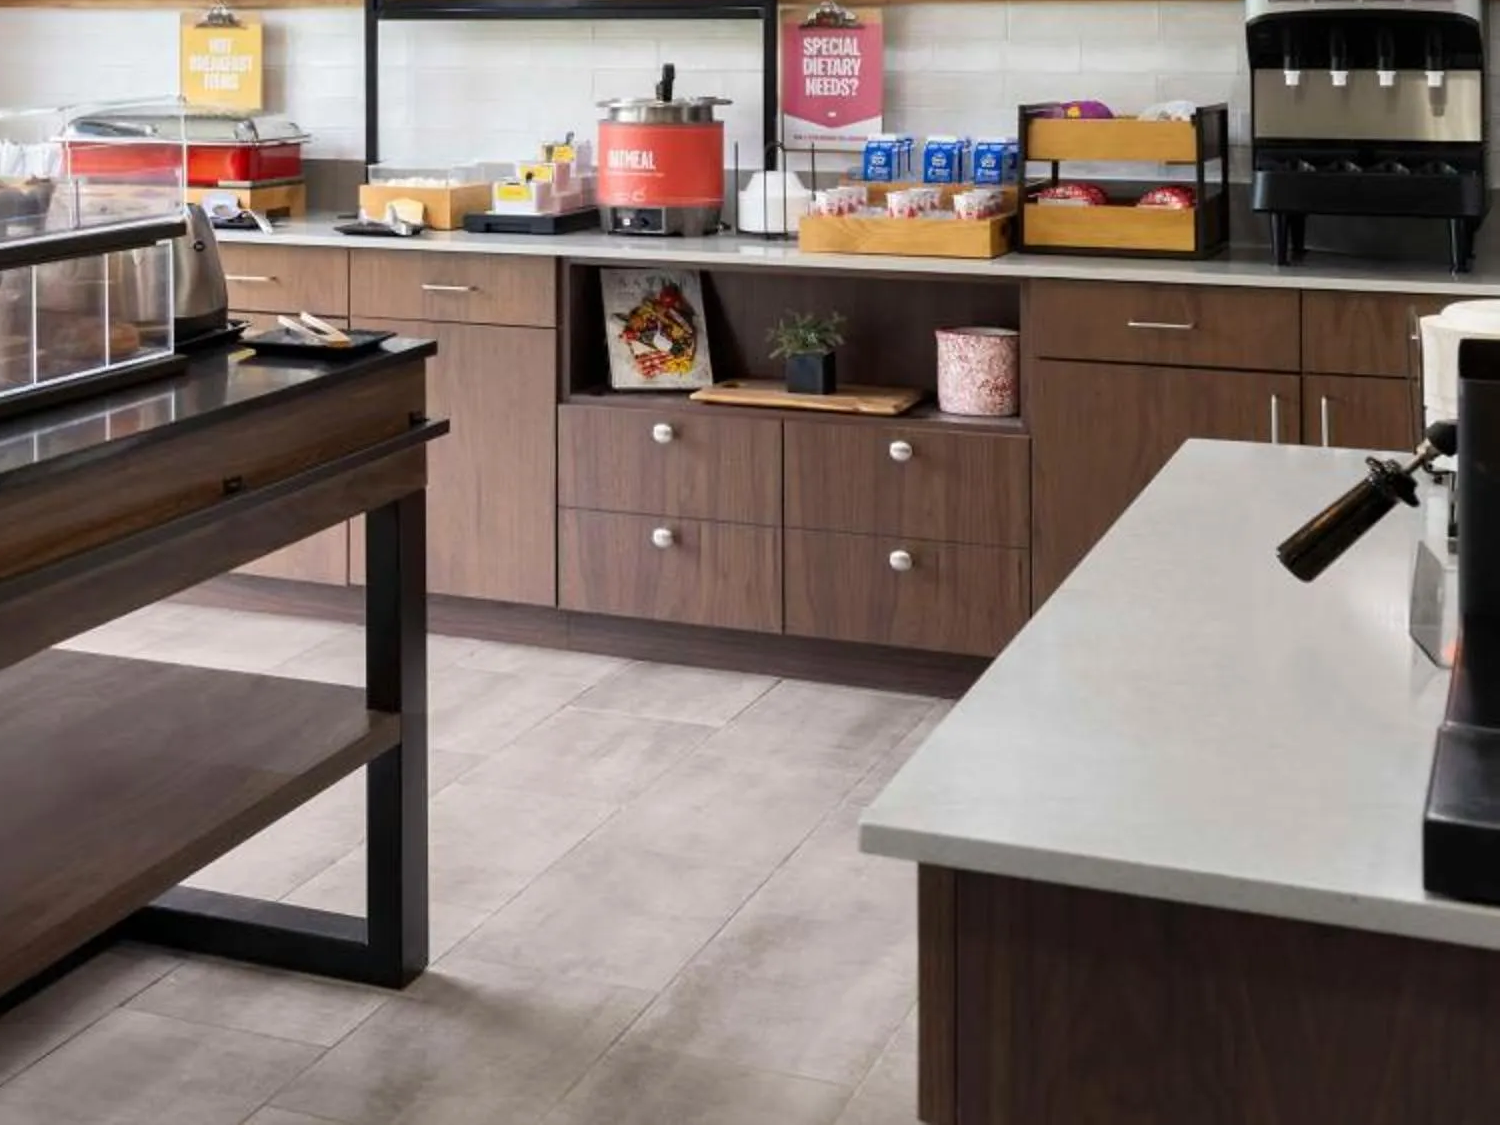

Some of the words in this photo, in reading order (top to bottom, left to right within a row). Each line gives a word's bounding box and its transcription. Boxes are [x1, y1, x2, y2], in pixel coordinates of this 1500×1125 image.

[803, 37, 861, 56] SPECIAL
[803, 58, 861, 76] DIETARY
[805, 77, 859, 96] NEEDS?
